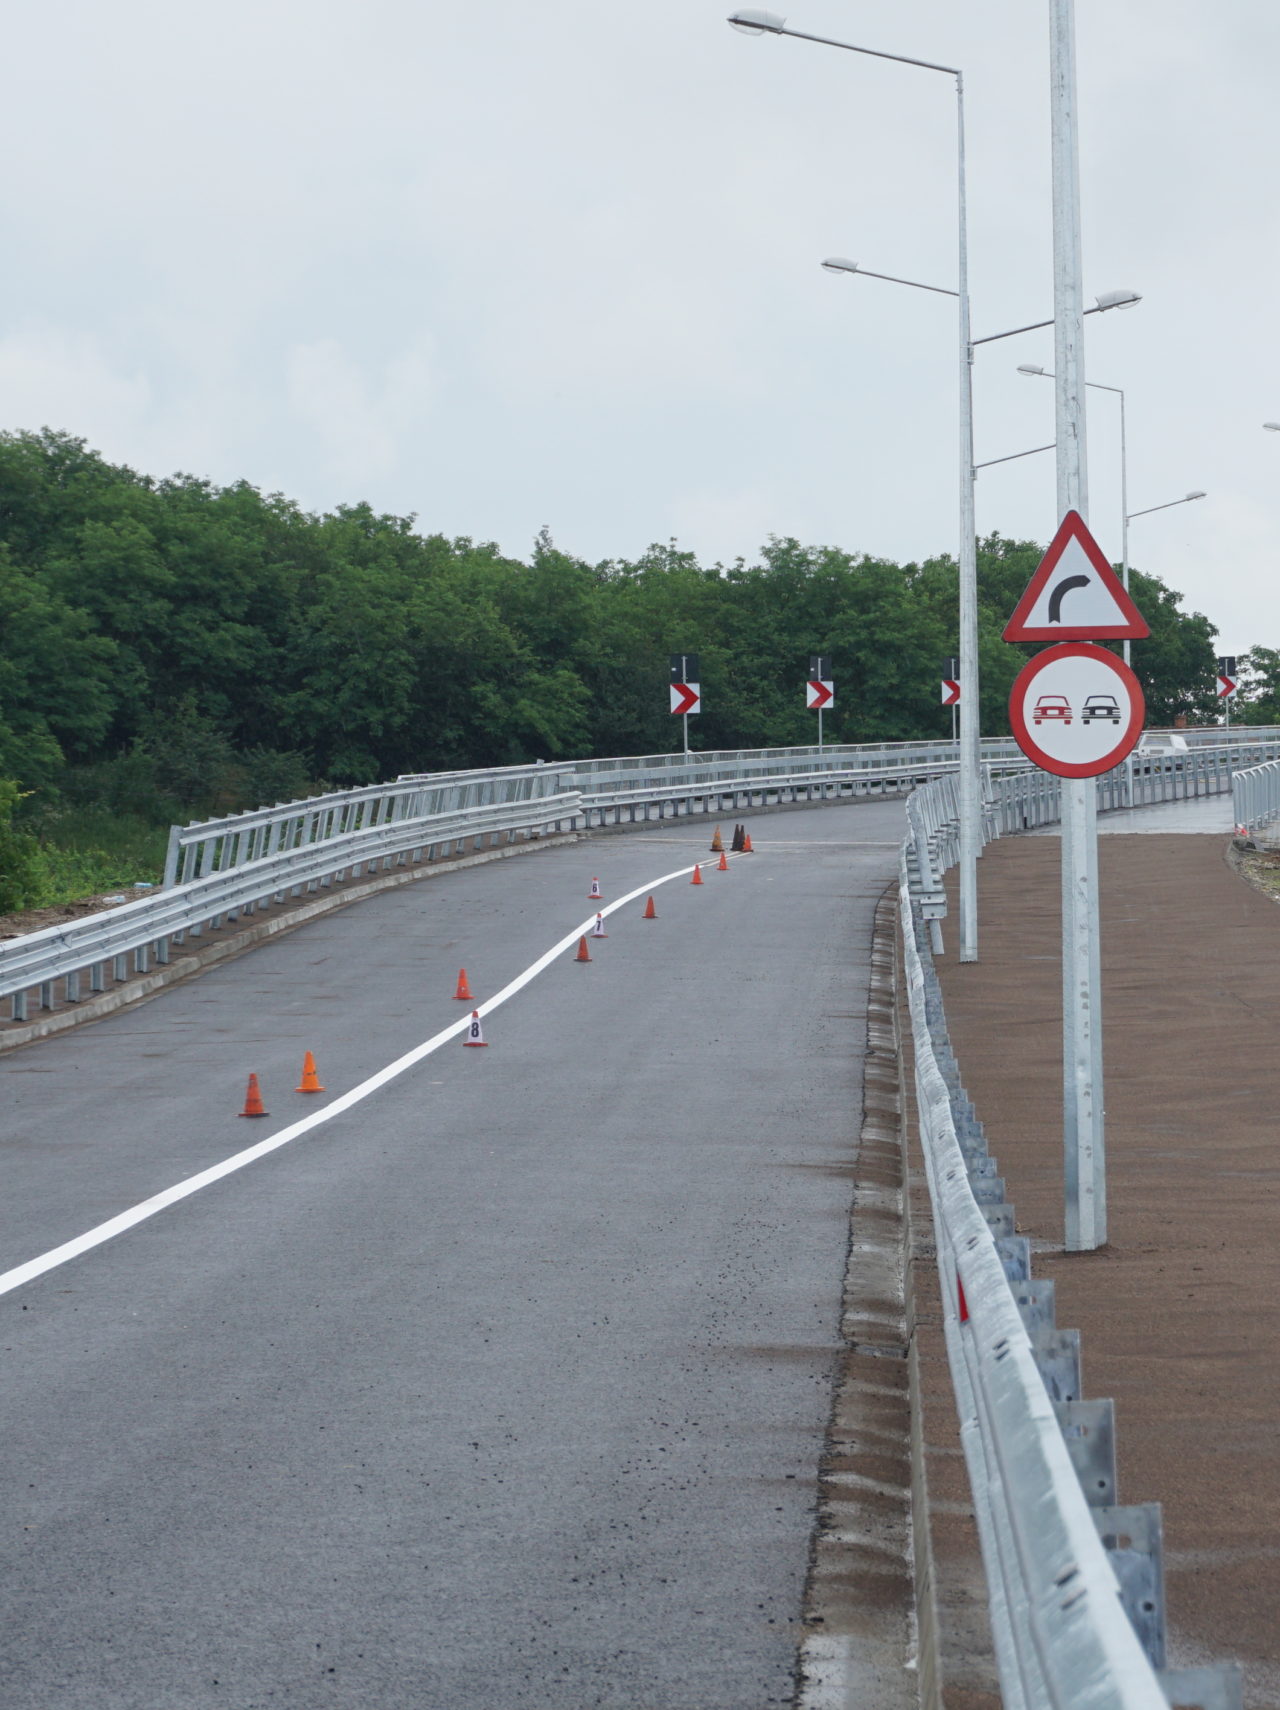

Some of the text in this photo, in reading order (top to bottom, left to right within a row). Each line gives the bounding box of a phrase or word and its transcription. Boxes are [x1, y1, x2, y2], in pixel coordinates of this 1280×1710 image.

[592, 883, 597, 892] 6
[596, 921, 601, 931] 7
[471, 1022, 479, 1037] 8
